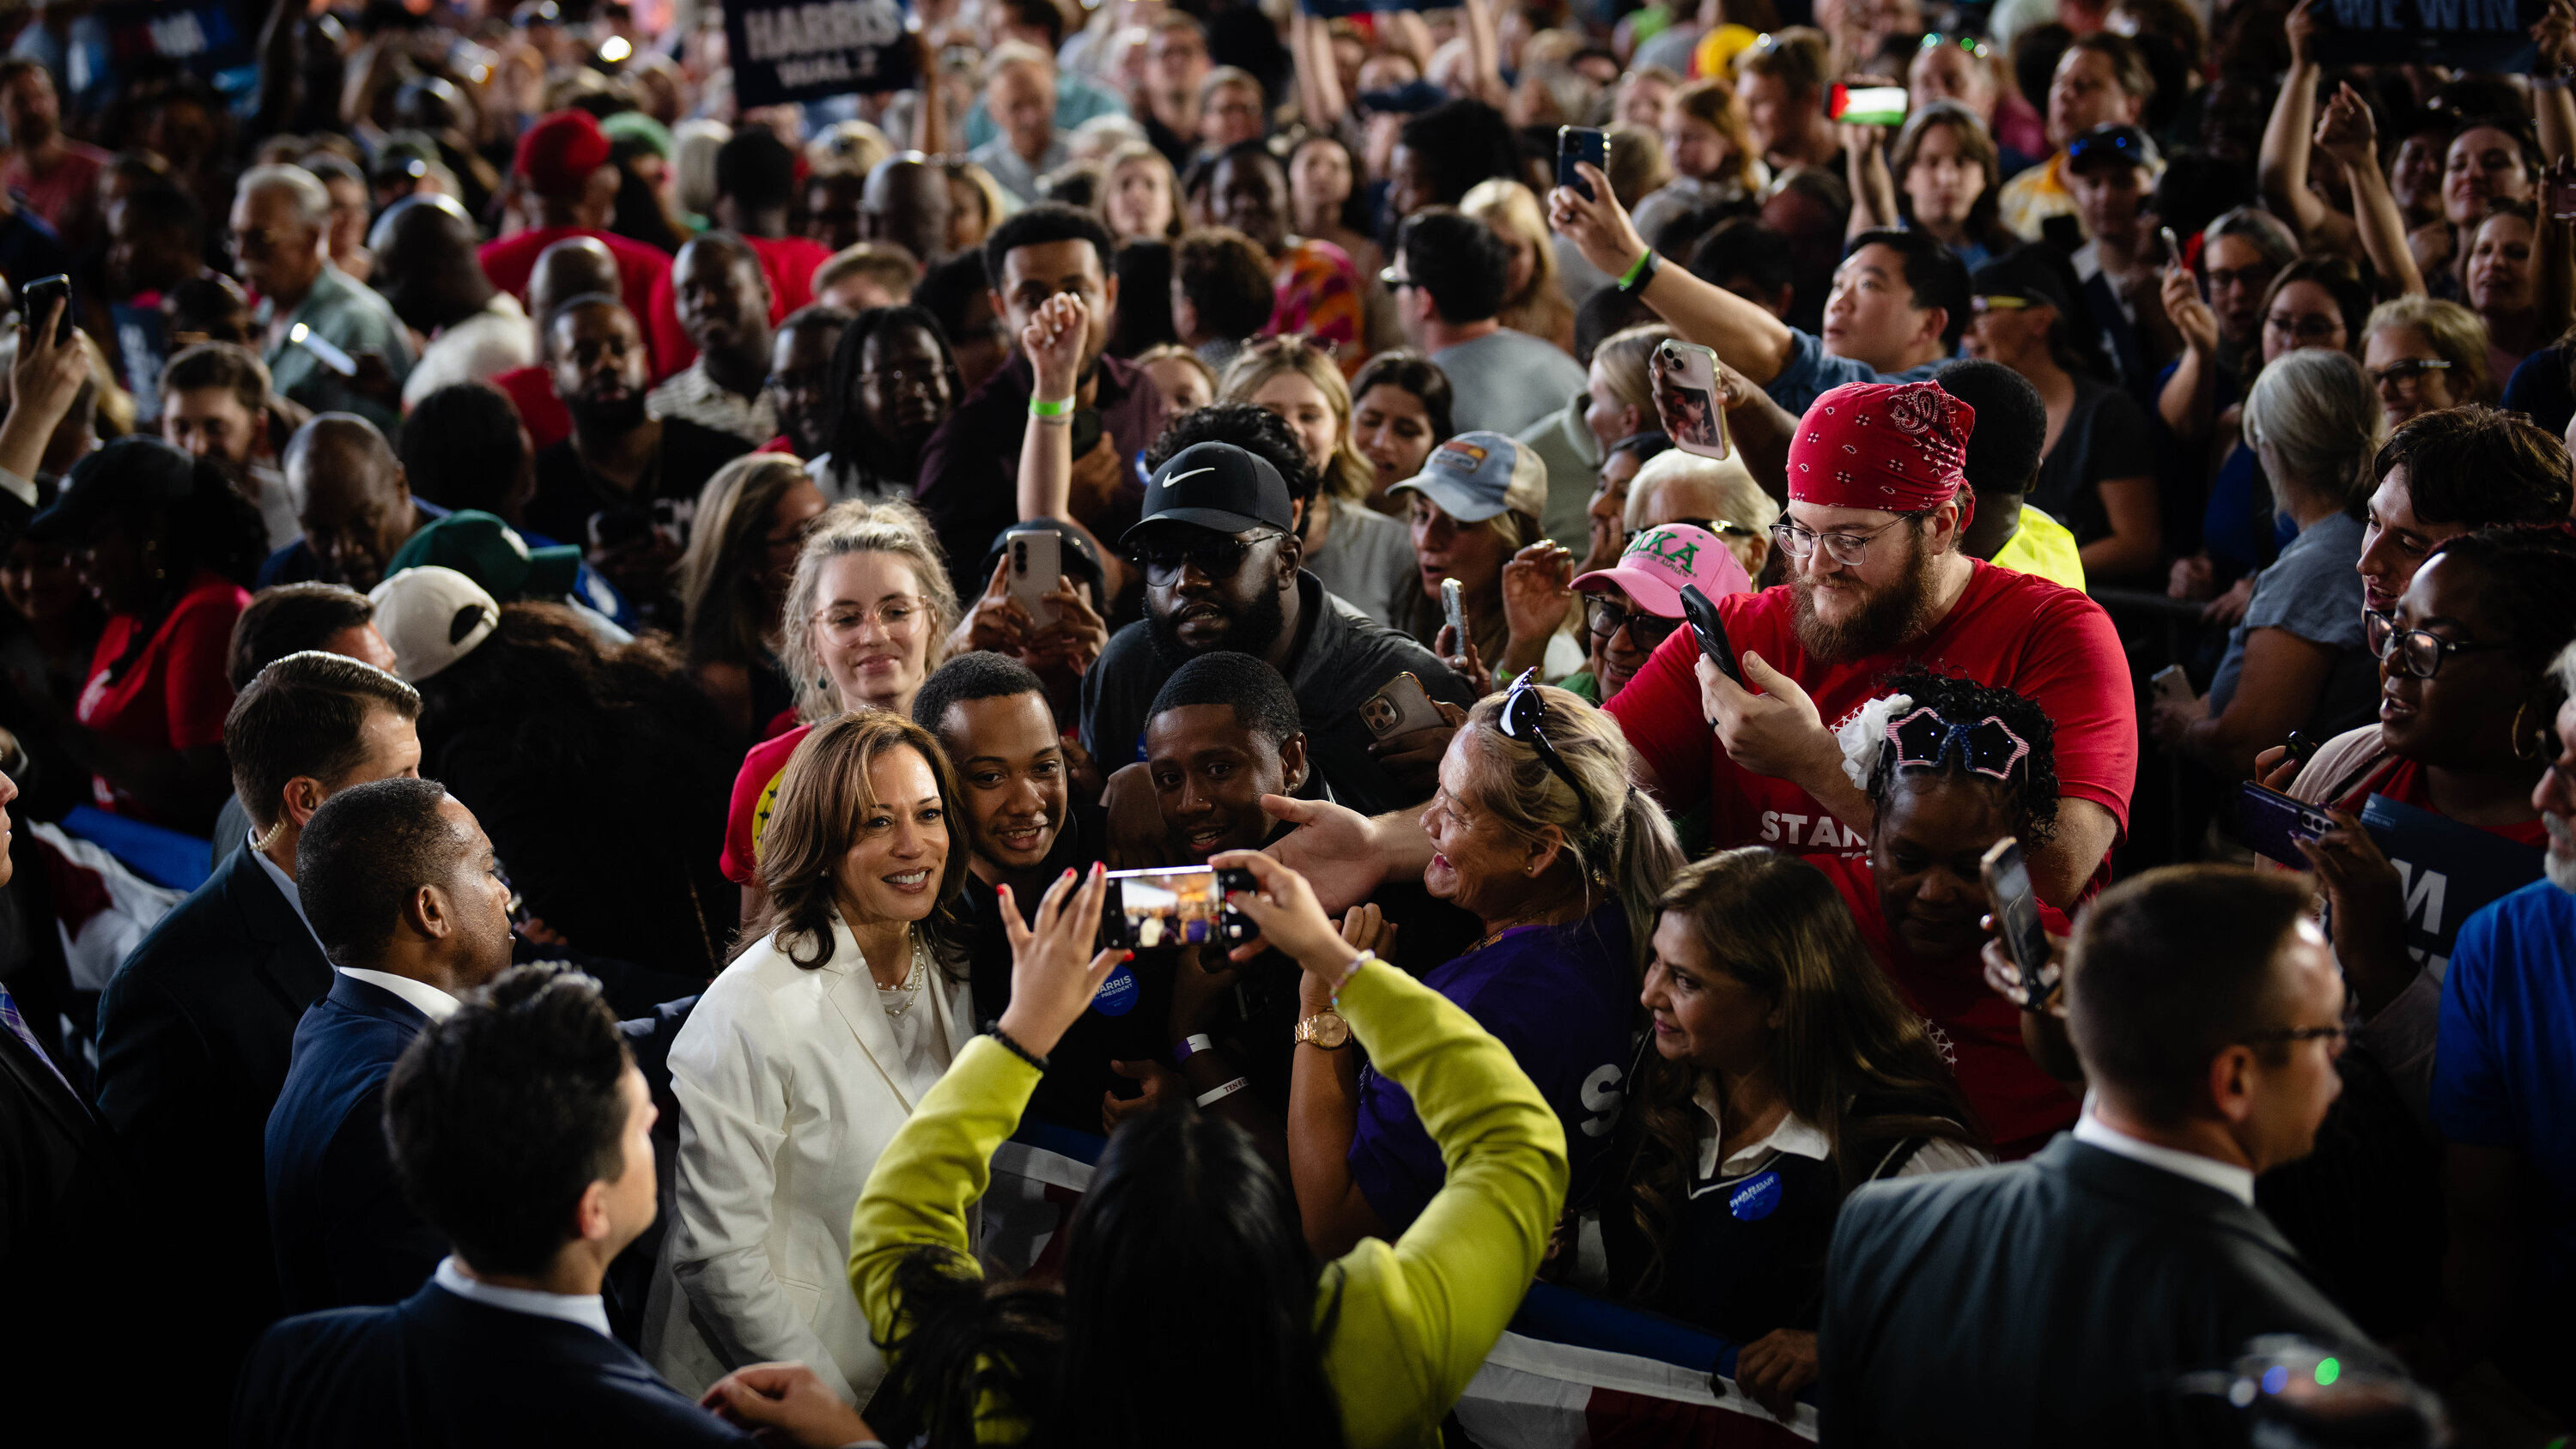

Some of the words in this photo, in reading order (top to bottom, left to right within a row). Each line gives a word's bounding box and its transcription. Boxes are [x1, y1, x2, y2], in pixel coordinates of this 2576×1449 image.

[744, 0, 900, 60] HARRIS
[2332, 0, 2403, 31] WE
[2415, 0, 2519, 32] WIN
[1621, 530, 1700, 573] AKA
[1101, 983, 1133, 998] PRESIDENT
